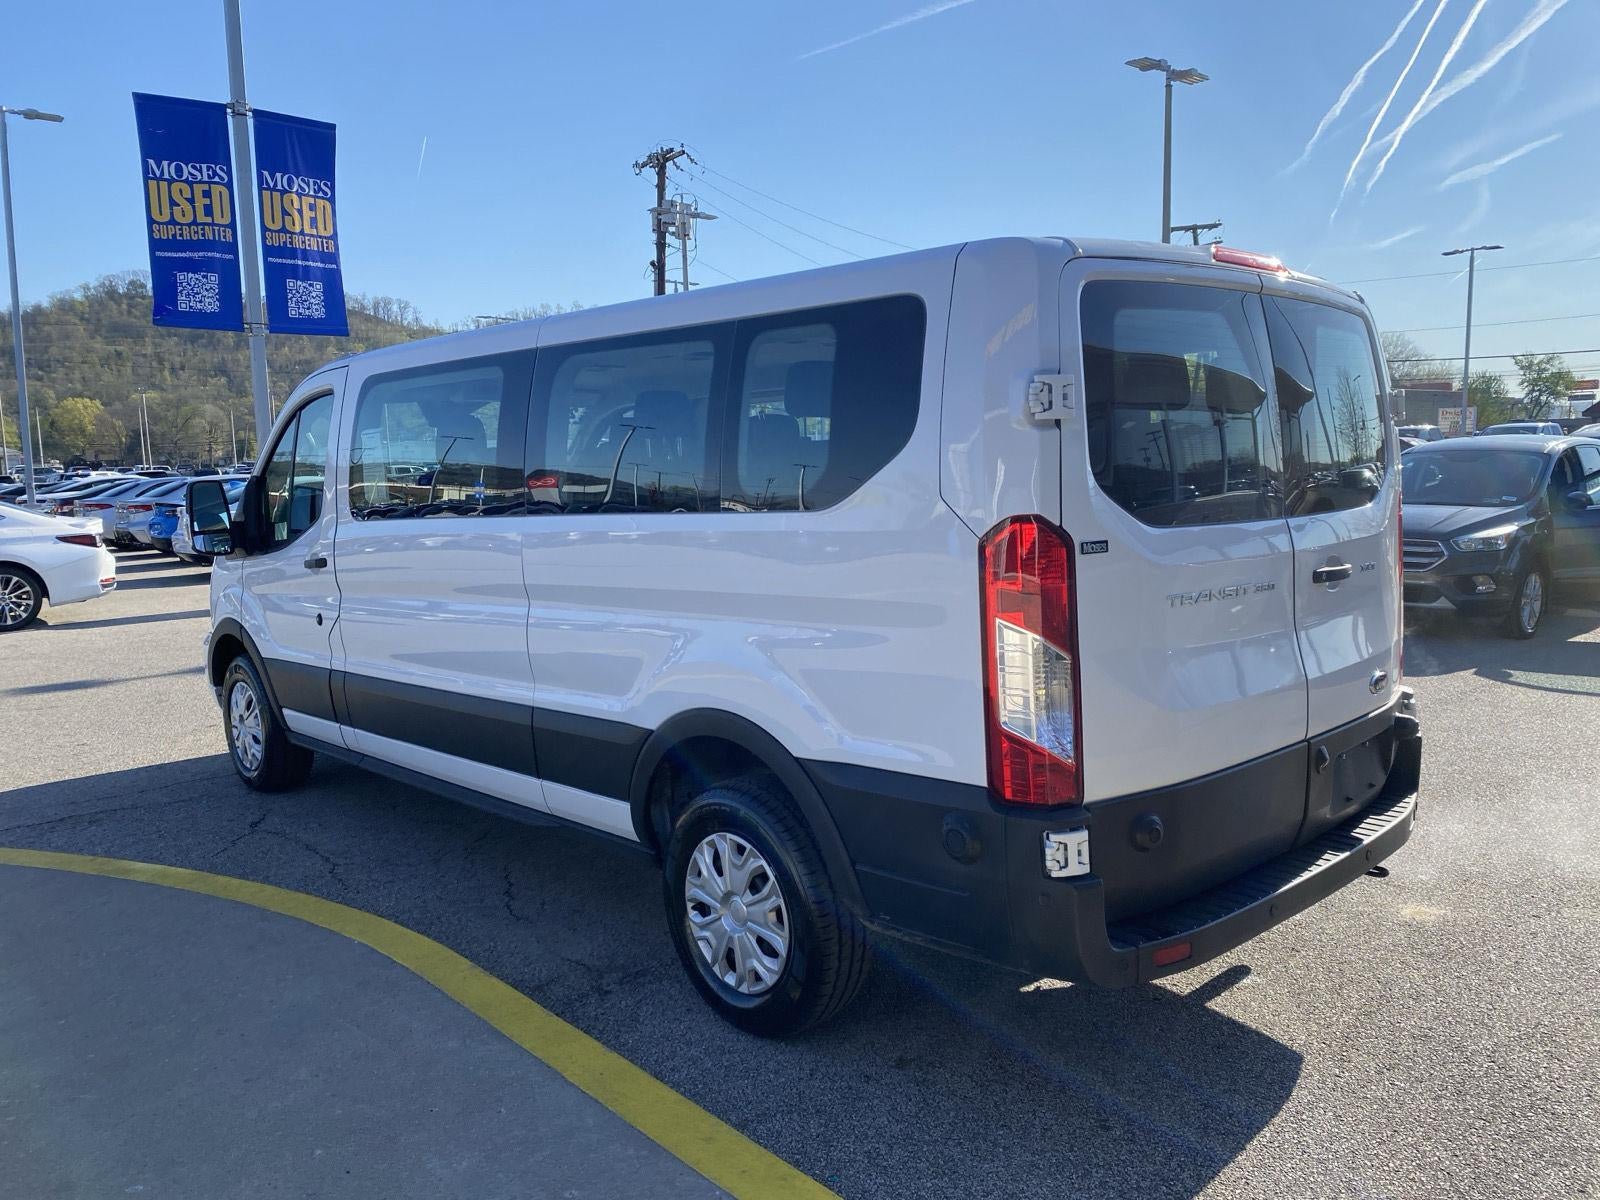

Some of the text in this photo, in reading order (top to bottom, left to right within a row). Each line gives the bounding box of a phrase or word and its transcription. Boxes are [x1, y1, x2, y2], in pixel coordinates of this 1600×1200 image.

[147, 159, 228, 183] MOSES
[261, 171, 332, 198] MOSES
[148, 180, 232, 225] USED
[262, 191, 334, 237] USED
[152, 224, 233, 243] SUPERCENTER
[265, 232, 335, 253] SUPERCENTER
[155, 250, 234, 260] mosesusedsupercenter.com
[267, 256, 337, 269] mosesusedsupercenter.com
[1167, 583, 1250, 608] TRANSIT
